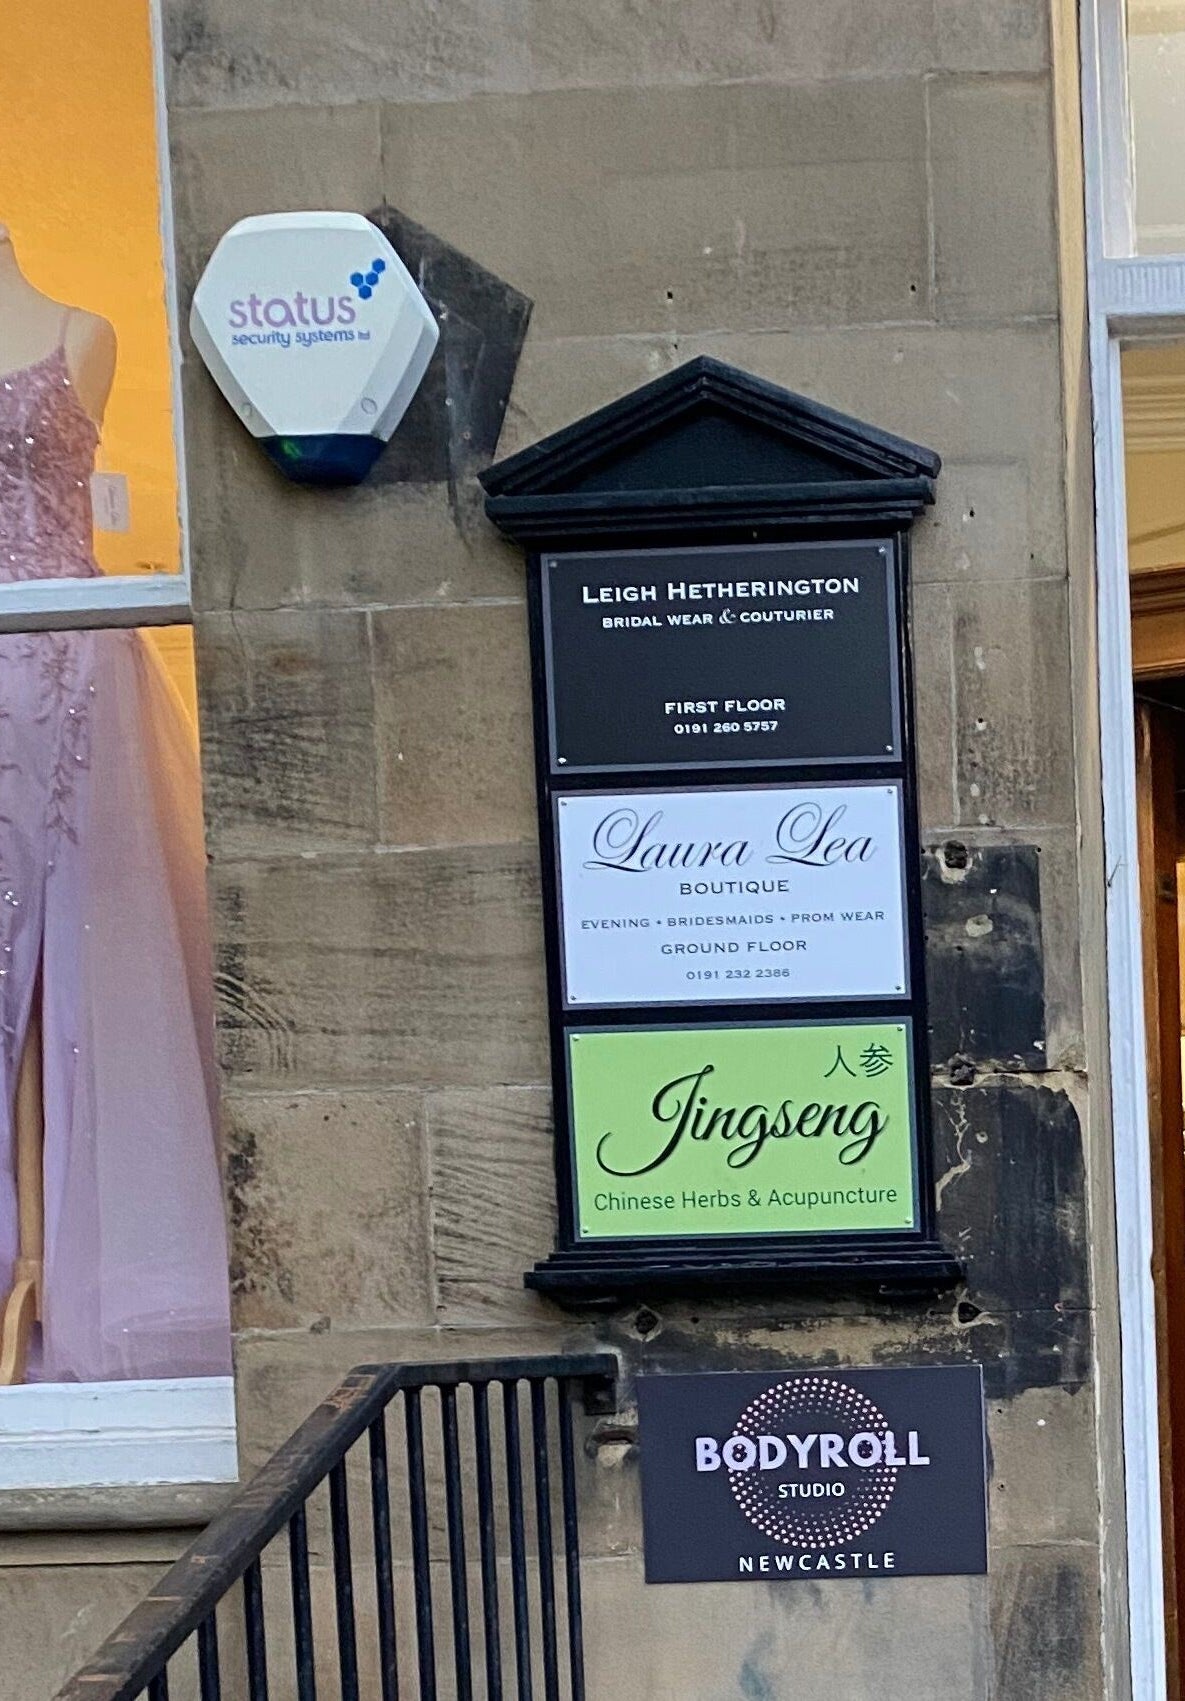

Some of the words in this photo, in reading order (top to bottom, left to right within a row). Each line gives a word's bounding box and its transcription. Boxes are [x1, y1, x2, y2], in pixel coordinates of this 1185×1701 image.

[229, 291, 357, 328] status
[231, 330, 291, 348] security
[295, 330, 355, 348] systems
[582, 585, 657, 604] LEIGH
[667, 577, 859, 600] HETHERINGTON
[602, 615, 663, 629] BRIDAL
[666, 613, 713, 626] WEAR
[718, 607, 737, 625] &
[739, 608, 834, 623] COUTURIER
[664, 702, 719, 715] FIRST
[724, 698, 786, 713] FLOOR
[673, 723, 708, 735] 0191
[713, 721, 741, 733] 260
[743, 720, 779, 732] 5757
[584, 808, 749, 873] Laura
[769, 802, 872, 867] Lea
[679, 880, 790, 896] BOUTIQUE
[581, 918, 650, 930] EVENING
[667, 914, 774, 927] BRIDESMAIDS
[791, 912, 835, 923] PROM
[840, 910, 885, 921] WEAR
[660, 942, 740, 955] GROUND
[746, 940, 807, 953] FLOOR
[685, 970, 719, 980] 0191
[724, 969, 752, 980] 232
[823, 1042, 894, 1078] 人参
[596, 1063, 888, 1177] Jingseng
[594, 1192, 675, 1211] Chinese
[681, 1189, 741, 1208] Herbs
[748, 1188, 762, 1207] &
[767, 1187, 898, 1209] Acupuncture
[695, 1429, 931, 1472] BODYROLL
[778, 1482, 845, 1499] STUDIO
[739, 1551, 895, 1572] NEWCASTLE
